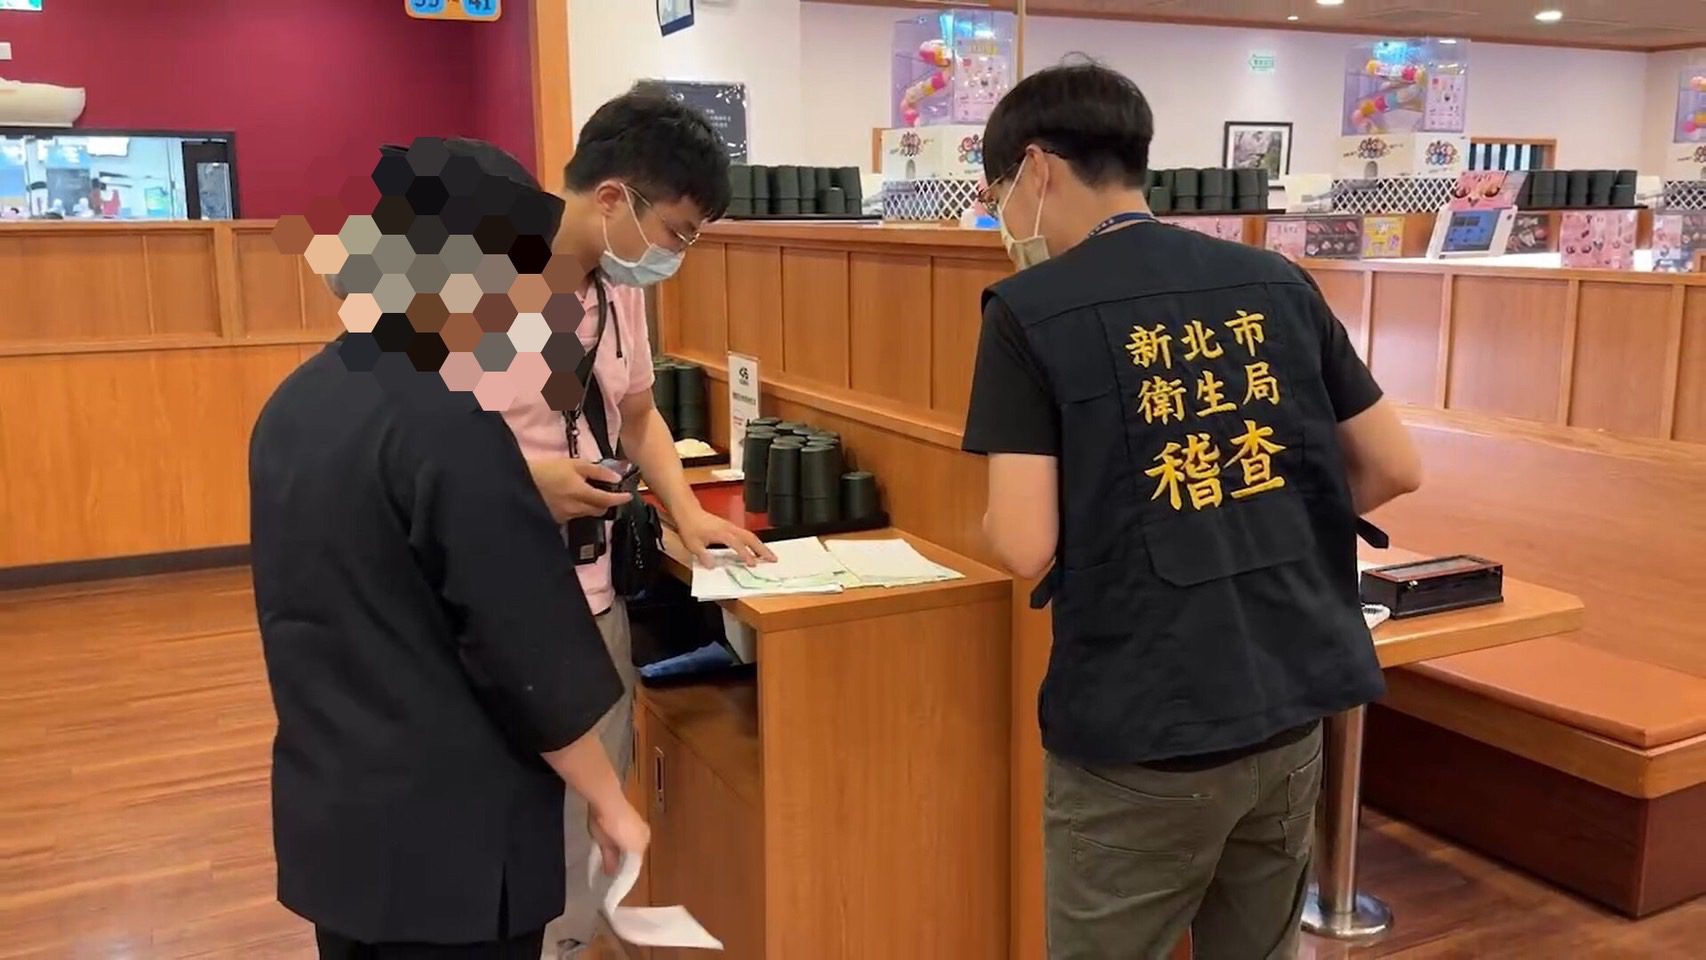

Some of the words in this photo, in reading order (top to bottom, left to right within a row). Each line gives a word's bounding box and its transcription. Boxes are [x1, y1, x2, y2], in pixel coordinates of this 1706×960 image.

[1126, 310, 1266, 369] 新北市
[1137, 361, 1281, 425] 衛生局
[1144, 420, 1287, 511] 稽查
